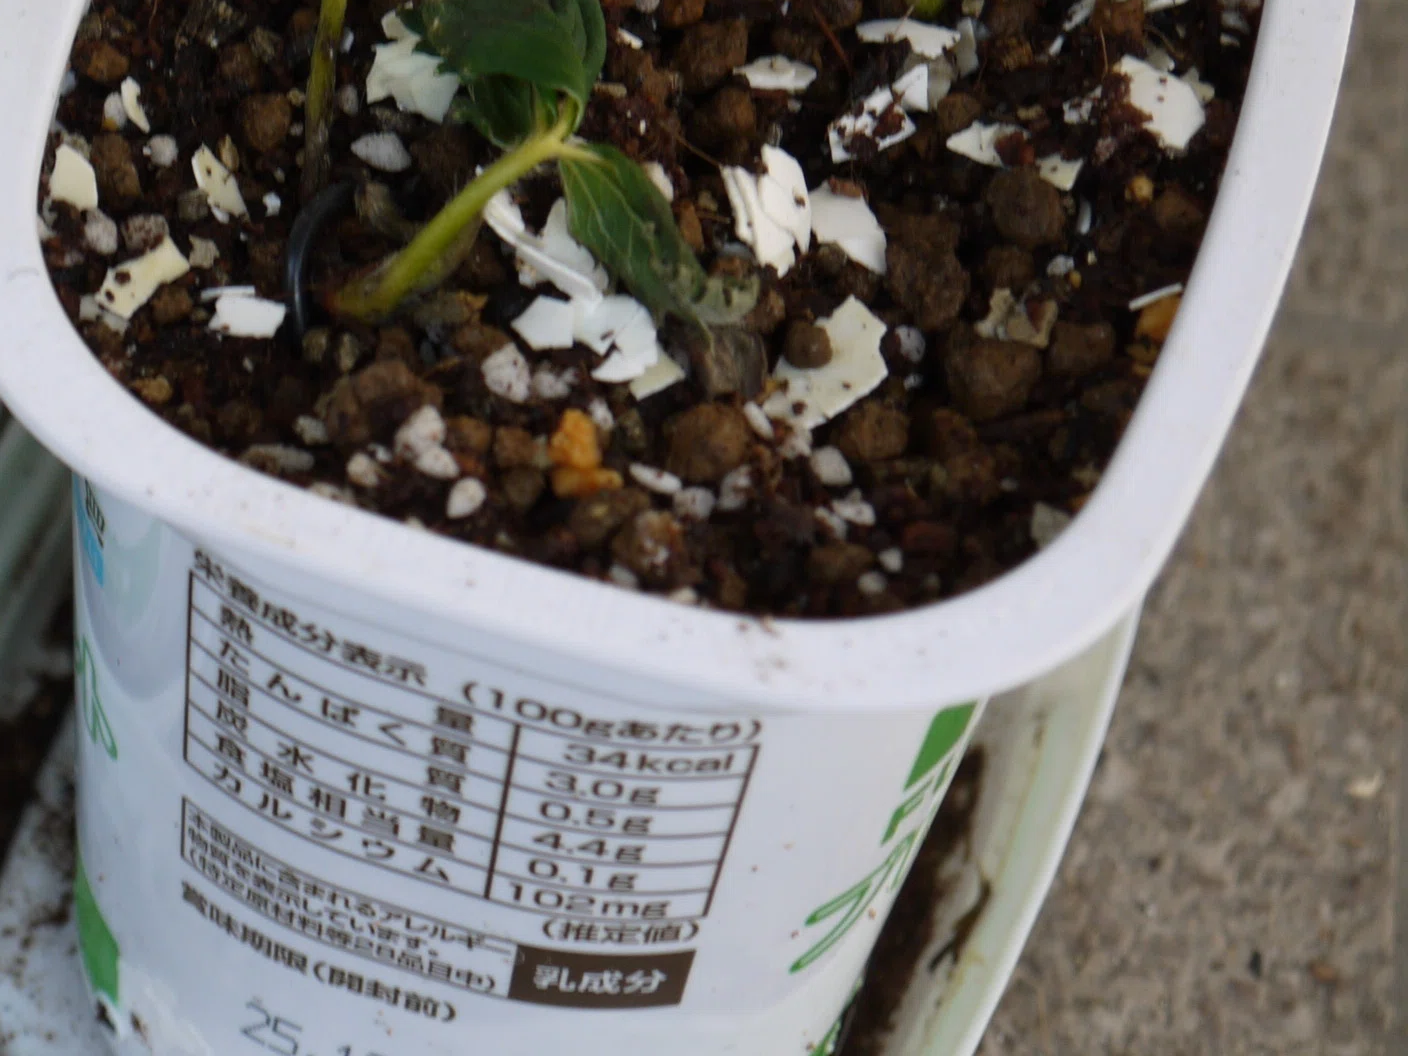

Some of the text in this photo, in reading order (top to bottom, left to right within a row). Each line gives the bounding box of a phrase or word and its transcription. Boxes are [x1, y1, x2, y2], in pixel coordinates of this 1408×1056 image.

[193, 547, 428, 687] 栄養成分表示
[219, 638, 661, 807] たんぱく質 3.0g
[562, 743, 736, 775] 34kcal
[538, 799, 654, 834] 0.5g
[213, 761, 672, 920] カルシウム 102mg
[531, 831, 646, 865] 4.4g
[528, 858, 640, 892] 0.1g
[541, 918, 701, 944] (推定値)
[533, 963, 667, 993] 乳成分
